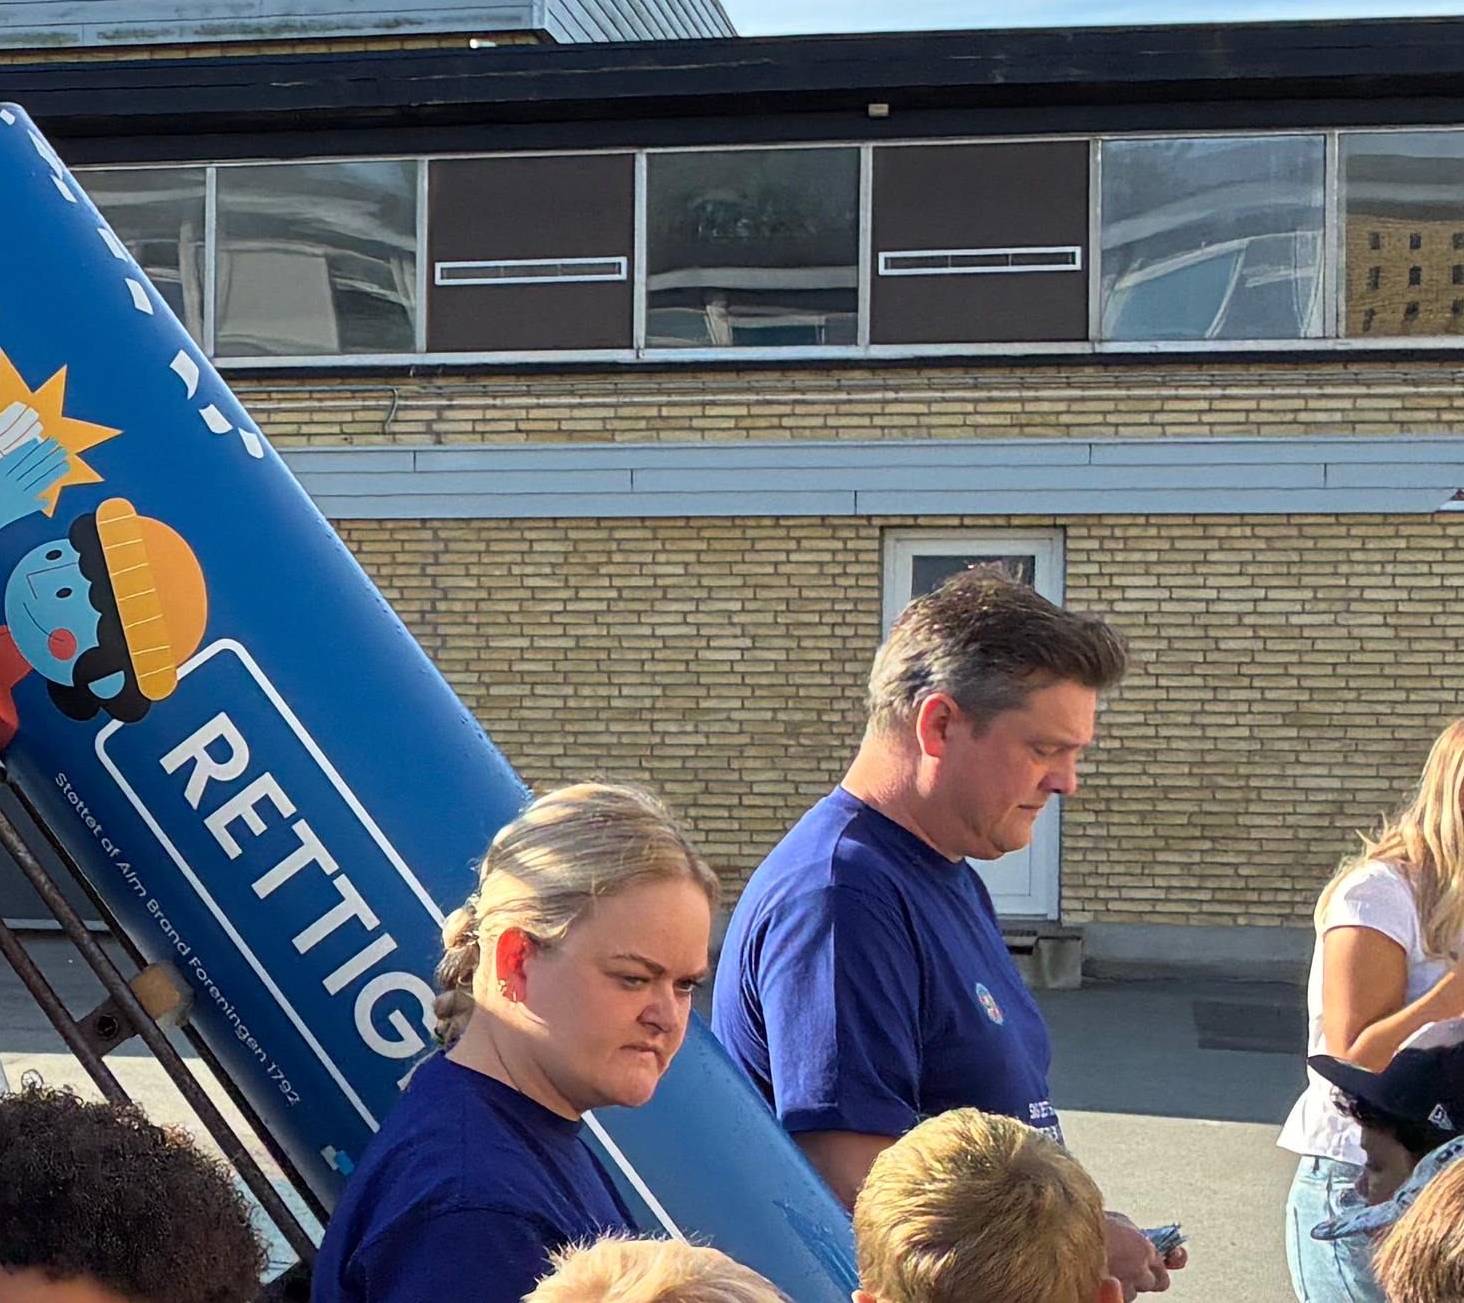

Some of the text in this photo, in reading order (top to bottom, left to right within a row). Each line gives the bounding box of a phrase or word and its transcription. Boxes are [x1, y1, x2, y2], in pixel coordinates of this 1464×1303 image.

[55, 772, 301, 1107] Støttet af Alm Brand Foreningen 1792
[159, 712, 439, 1090] RETTIG
